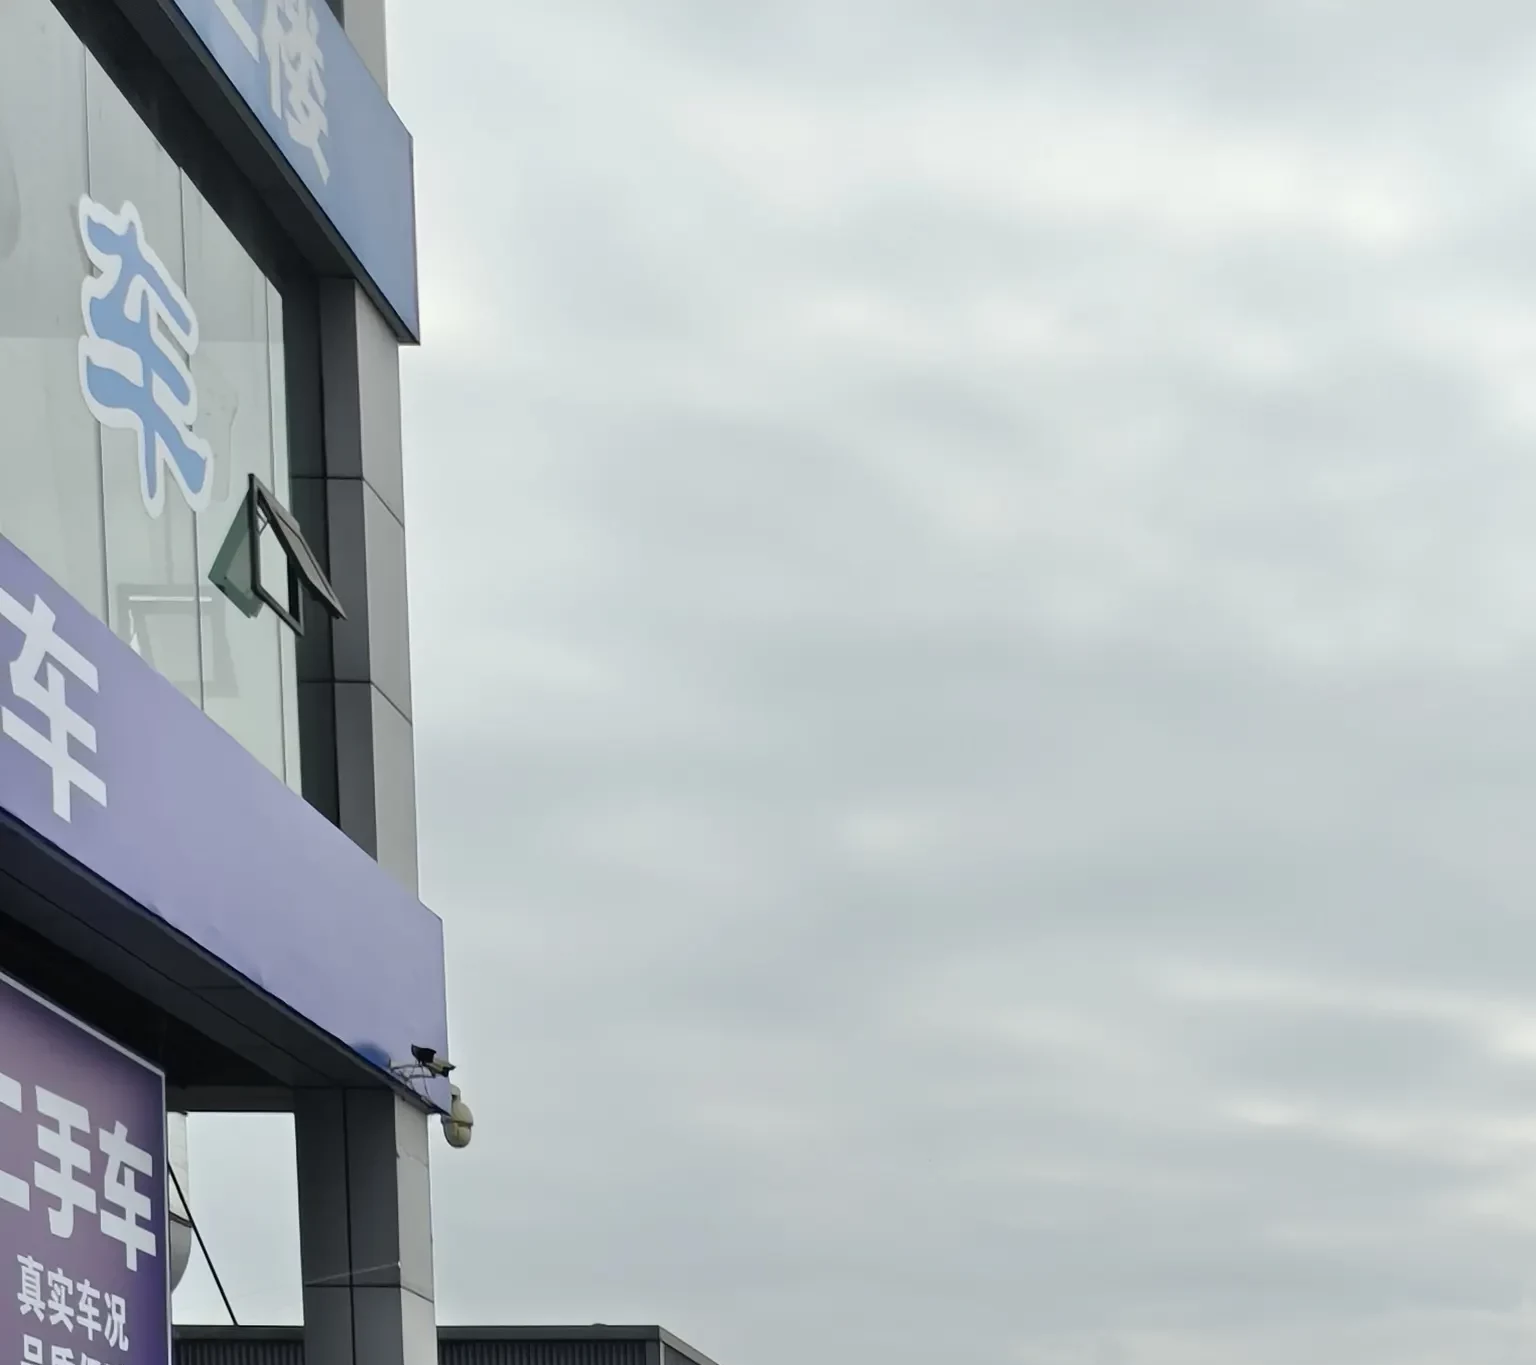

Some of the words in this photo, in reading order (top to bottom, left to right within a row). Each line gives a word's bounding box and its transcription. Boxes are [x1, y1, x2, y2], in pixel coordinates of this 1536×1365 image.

[79, 195, 214, 519] 车
[0, 587, 107, 823] 车
[16, 1254, 129, 1352] 真实车况
